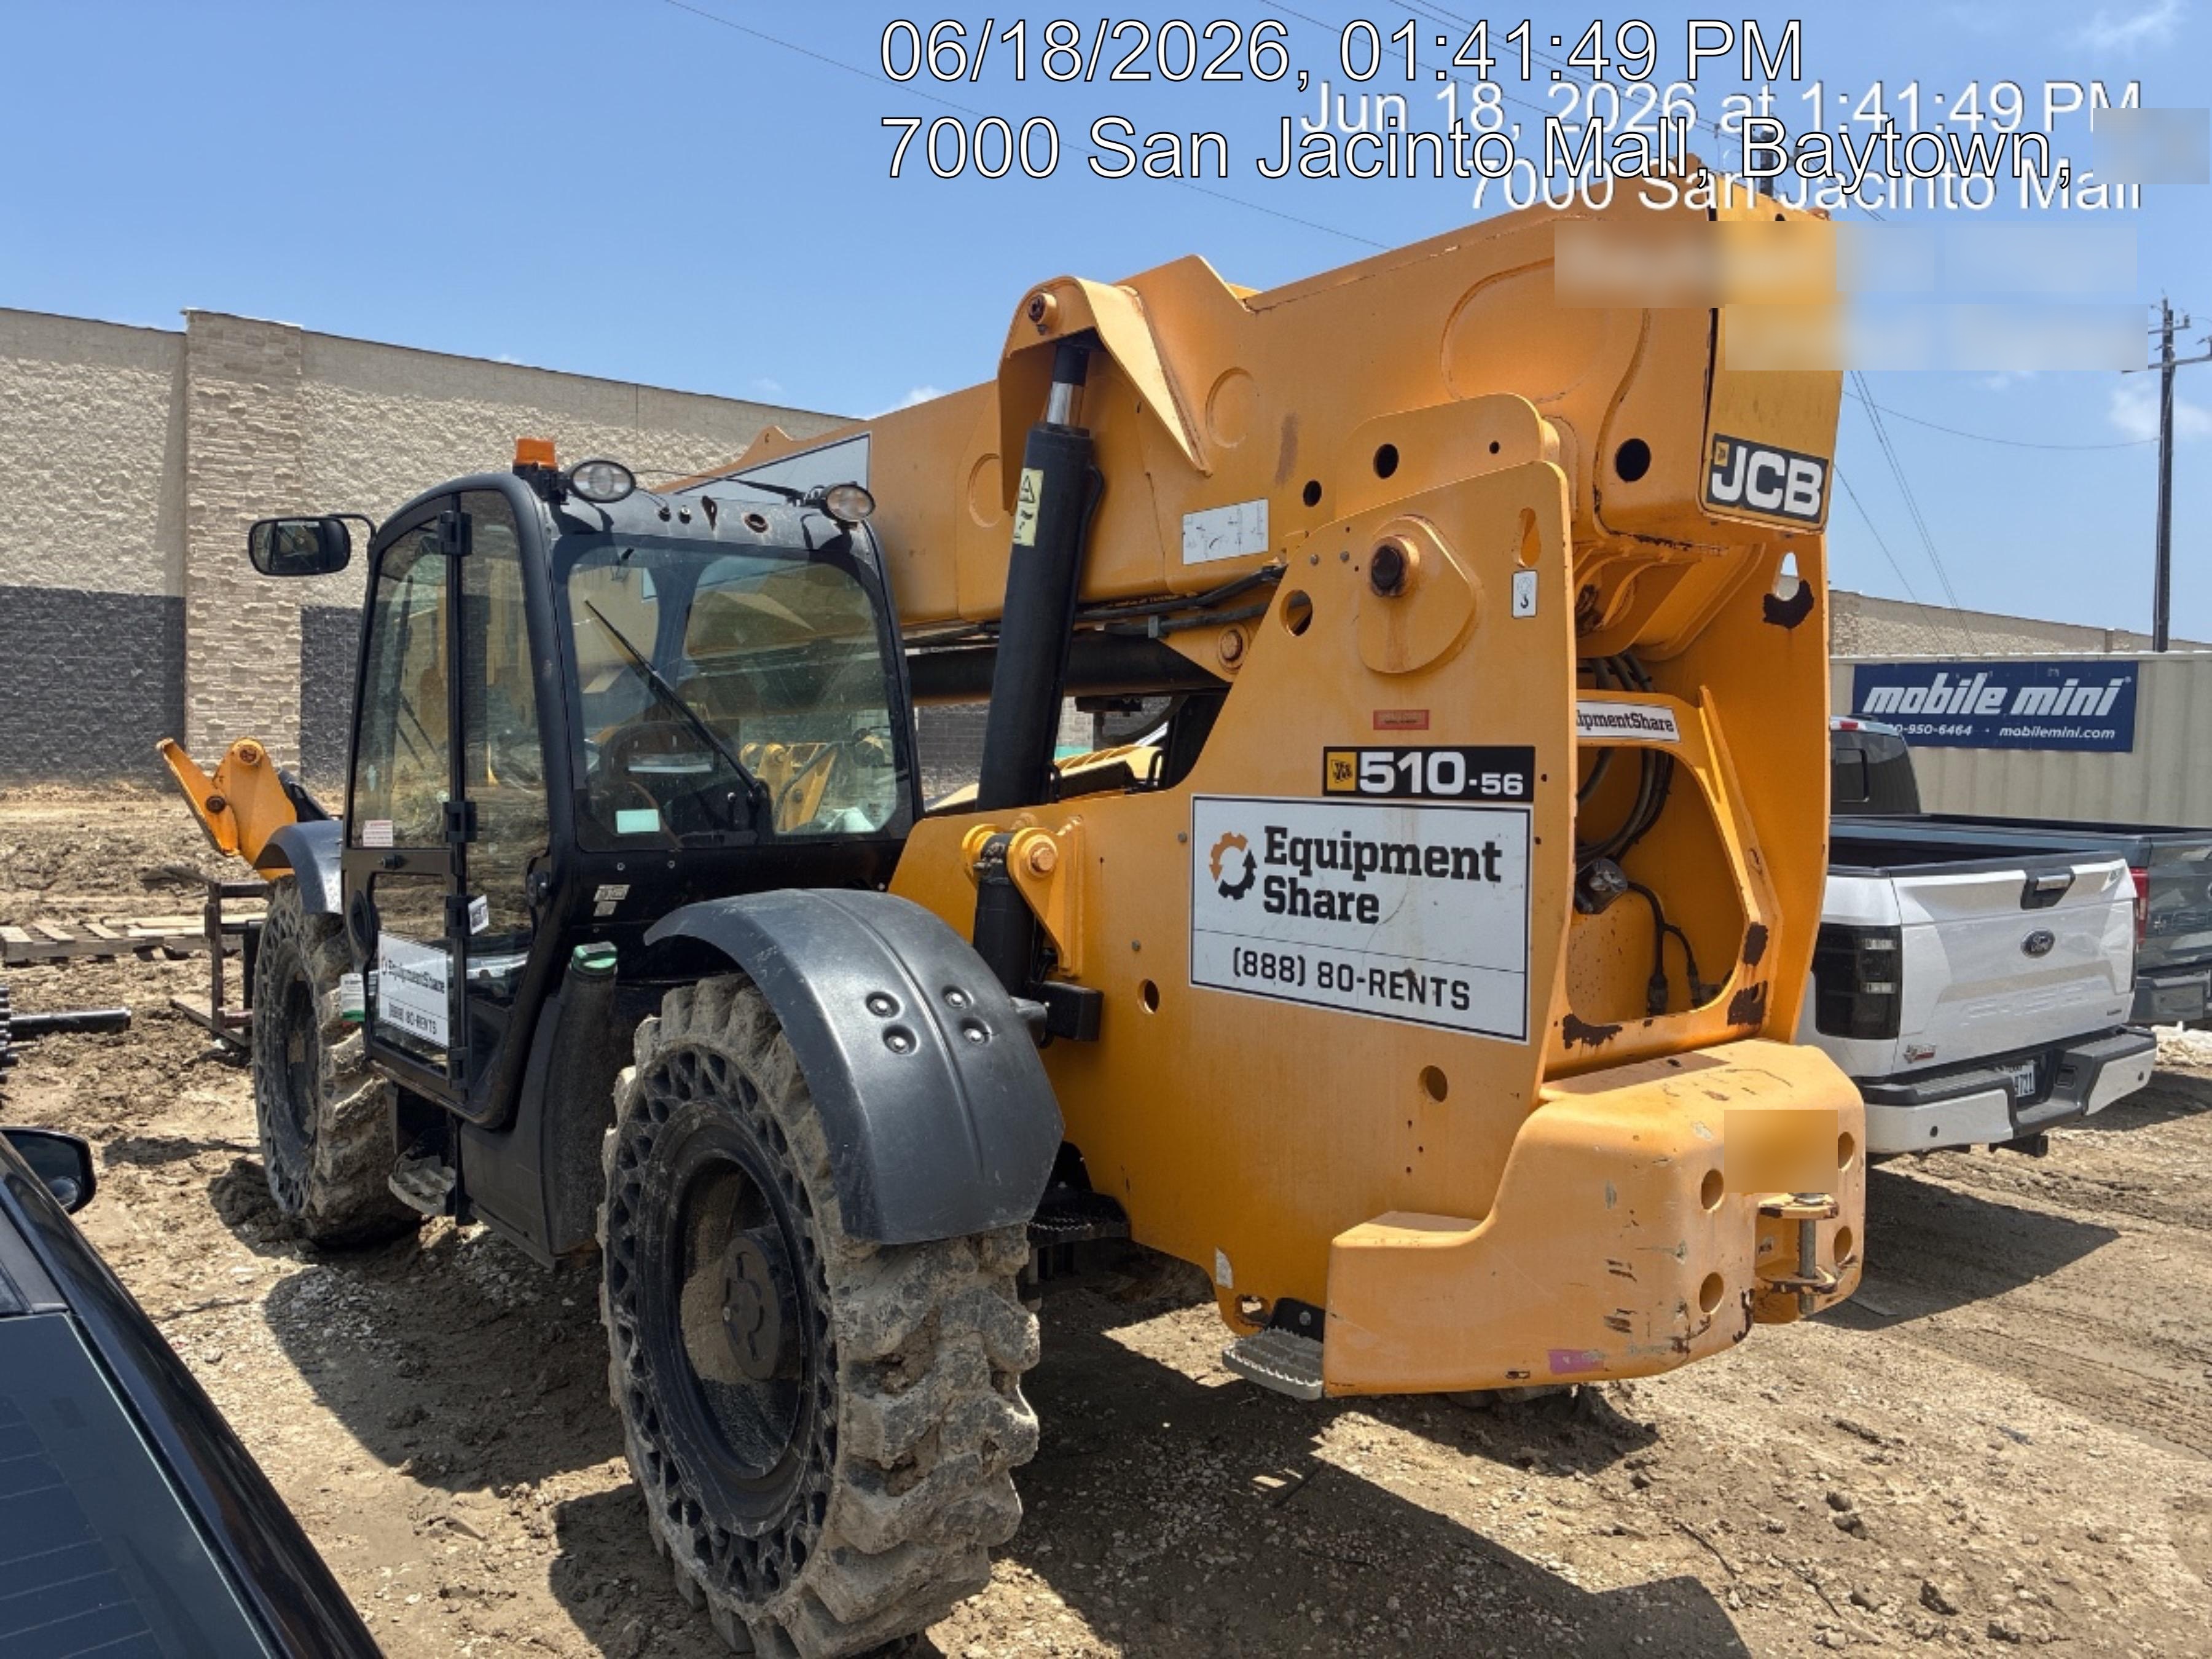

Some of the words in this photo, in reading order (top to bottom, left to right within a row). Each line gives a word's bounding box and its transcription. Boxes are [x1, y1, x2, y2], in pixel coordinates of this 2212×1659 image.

[1711, 445, 1823, 517] JCB
[1862, 672, 2008, 715] mobile
[2010, 678, 2125, 716] mini
[1999, 726, 2116, 739] mobilemini.com
[1263, 825, 1502, 882] Equipment
[1263, 875, 1379, 925] Share
[1233, 947, 1306, 987] (888)
[1317, 960, 1470, 1011] 80-RENTS
